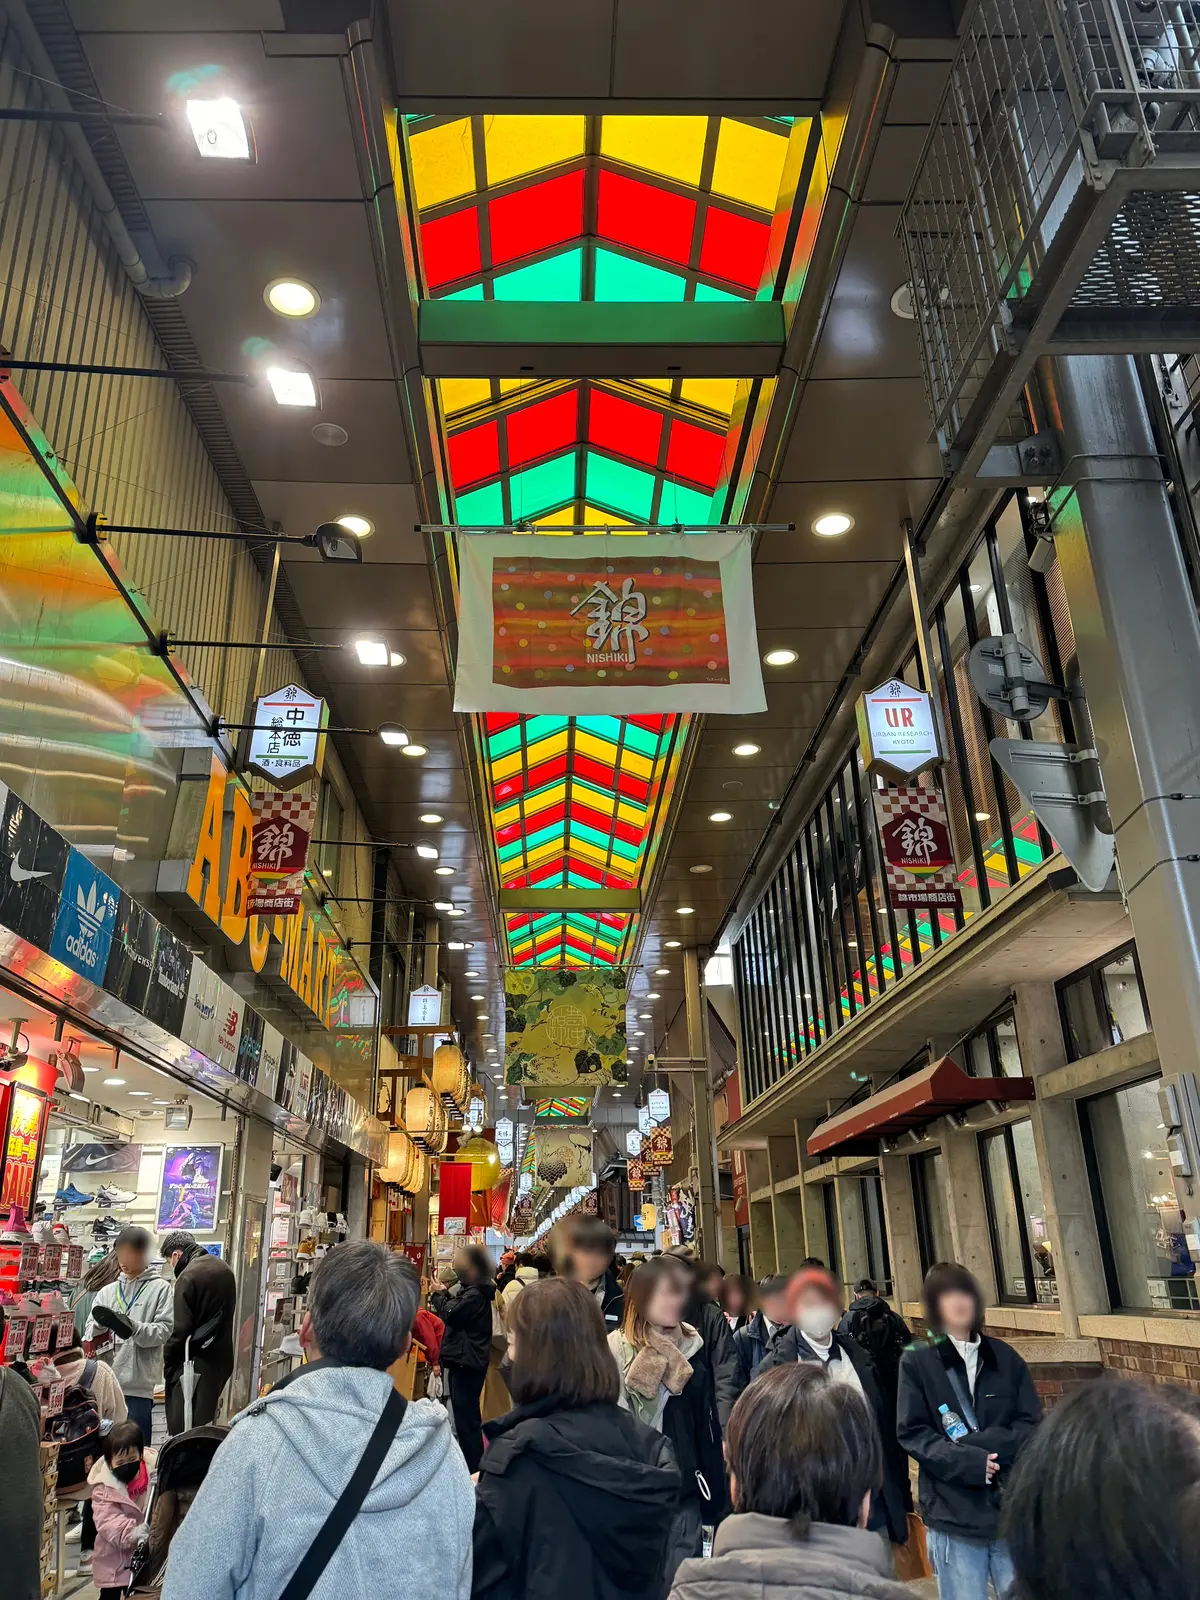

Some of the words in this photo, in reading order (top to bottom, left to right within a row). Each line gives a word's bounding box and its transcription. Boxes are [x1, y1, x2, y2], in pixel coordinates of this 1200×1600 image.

[570, 578, 650, 664] 錦
[586, 653, 628, 663] NISHIKI
[885, 707, 914, 728] UR
[252, 822, 294, 871] 錦
[892, 817, 938, 866] 錦
[901, 857, 927, 865] NISHIKI
[65, 935, 97, 968] adidas
[2, 1160, 34, 1210] SALE
